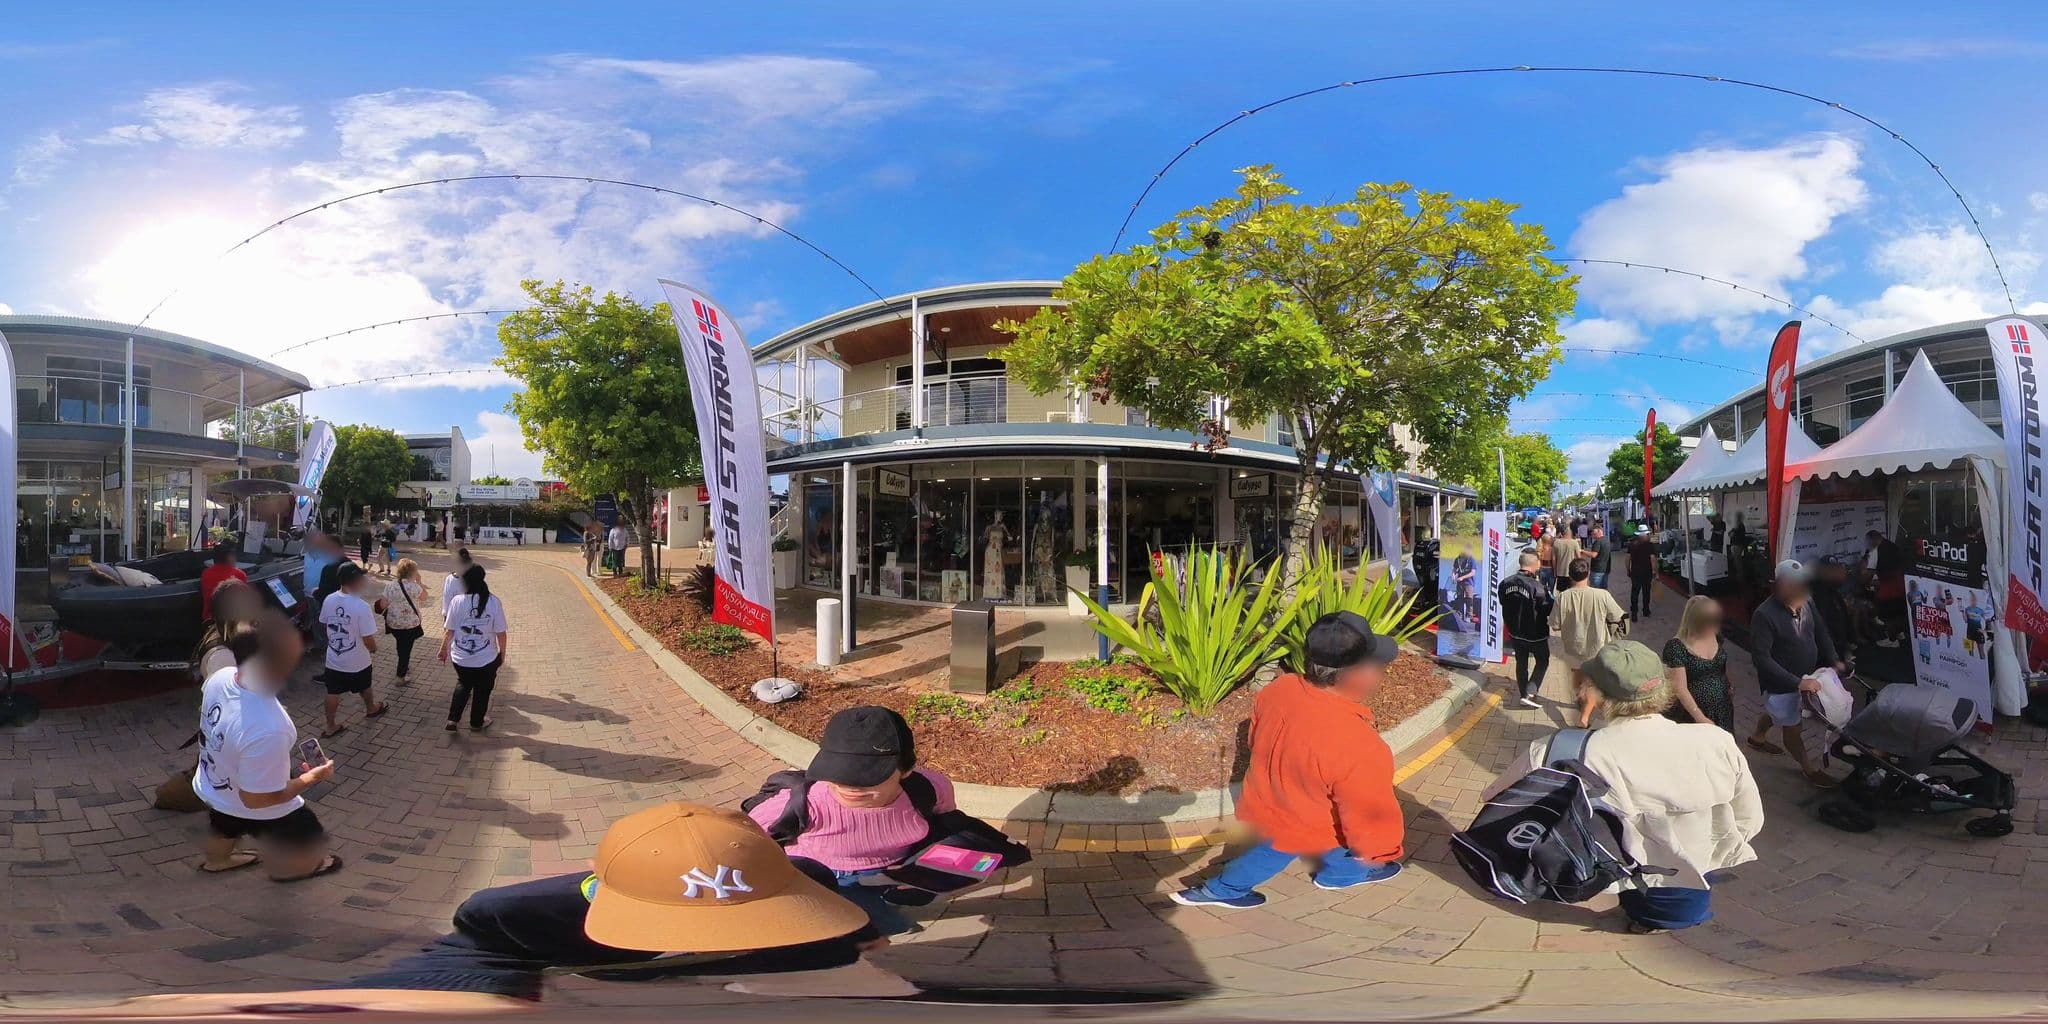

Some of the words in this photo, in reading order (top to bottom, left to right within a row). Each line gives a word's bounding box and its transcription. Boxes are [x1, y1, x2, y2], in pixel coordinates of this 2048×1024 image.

[708, 338, 738, 493] STORM
[2019, 356, 2041, 498] STORM
[1490, 549, 1499, 613] STORM
[723, 603, 755, 626] BOATS
[1927, 607, 1948, 620] YOUR
[1487, 615, 1497, 649] SEA
[680, 864, 753, 899] NY
